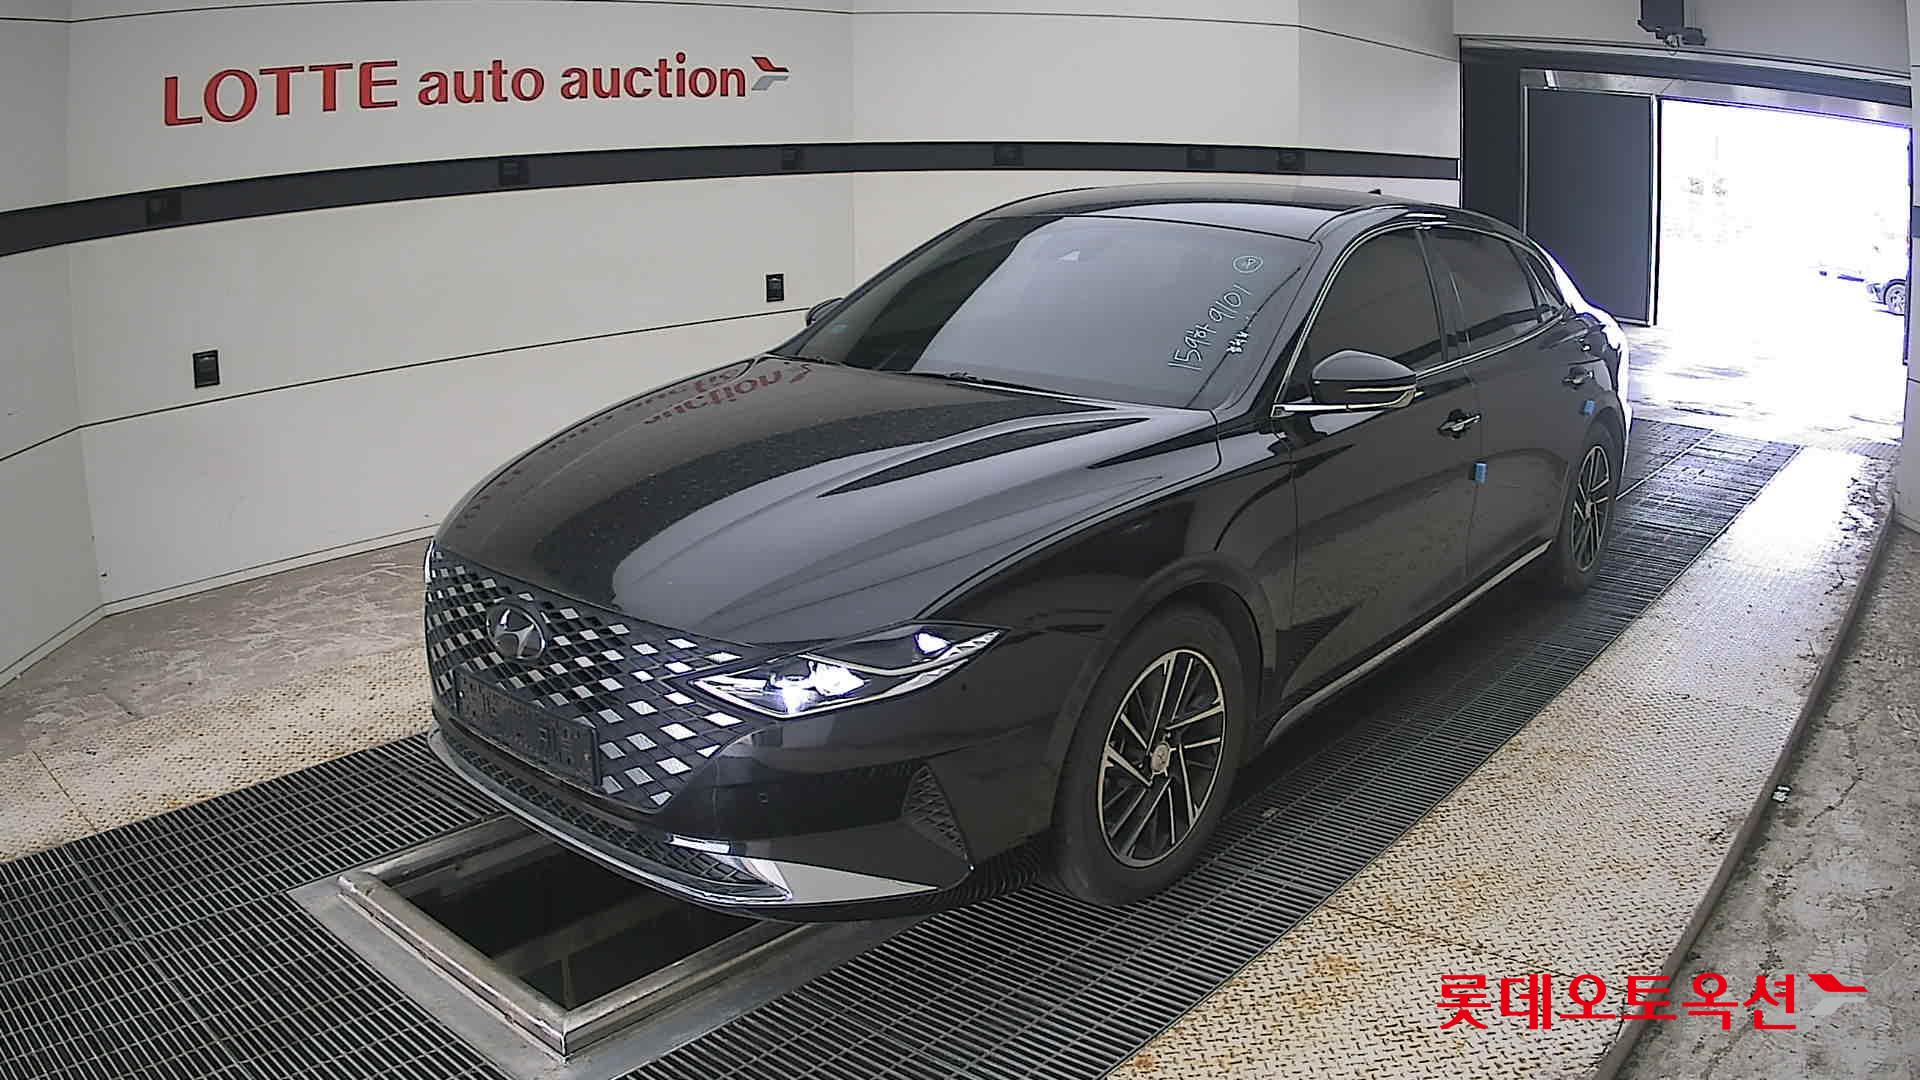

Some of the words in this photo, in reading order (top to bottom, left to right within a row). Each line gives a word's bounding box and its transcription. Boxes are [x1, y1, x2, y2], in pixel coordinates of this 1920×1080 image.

[163, 60, 398, 127] LOTTE
[417, 59, 545, 106] auto
[560, 52, 748, 100] auction
[1208, 284, 1253, 322] 9101
